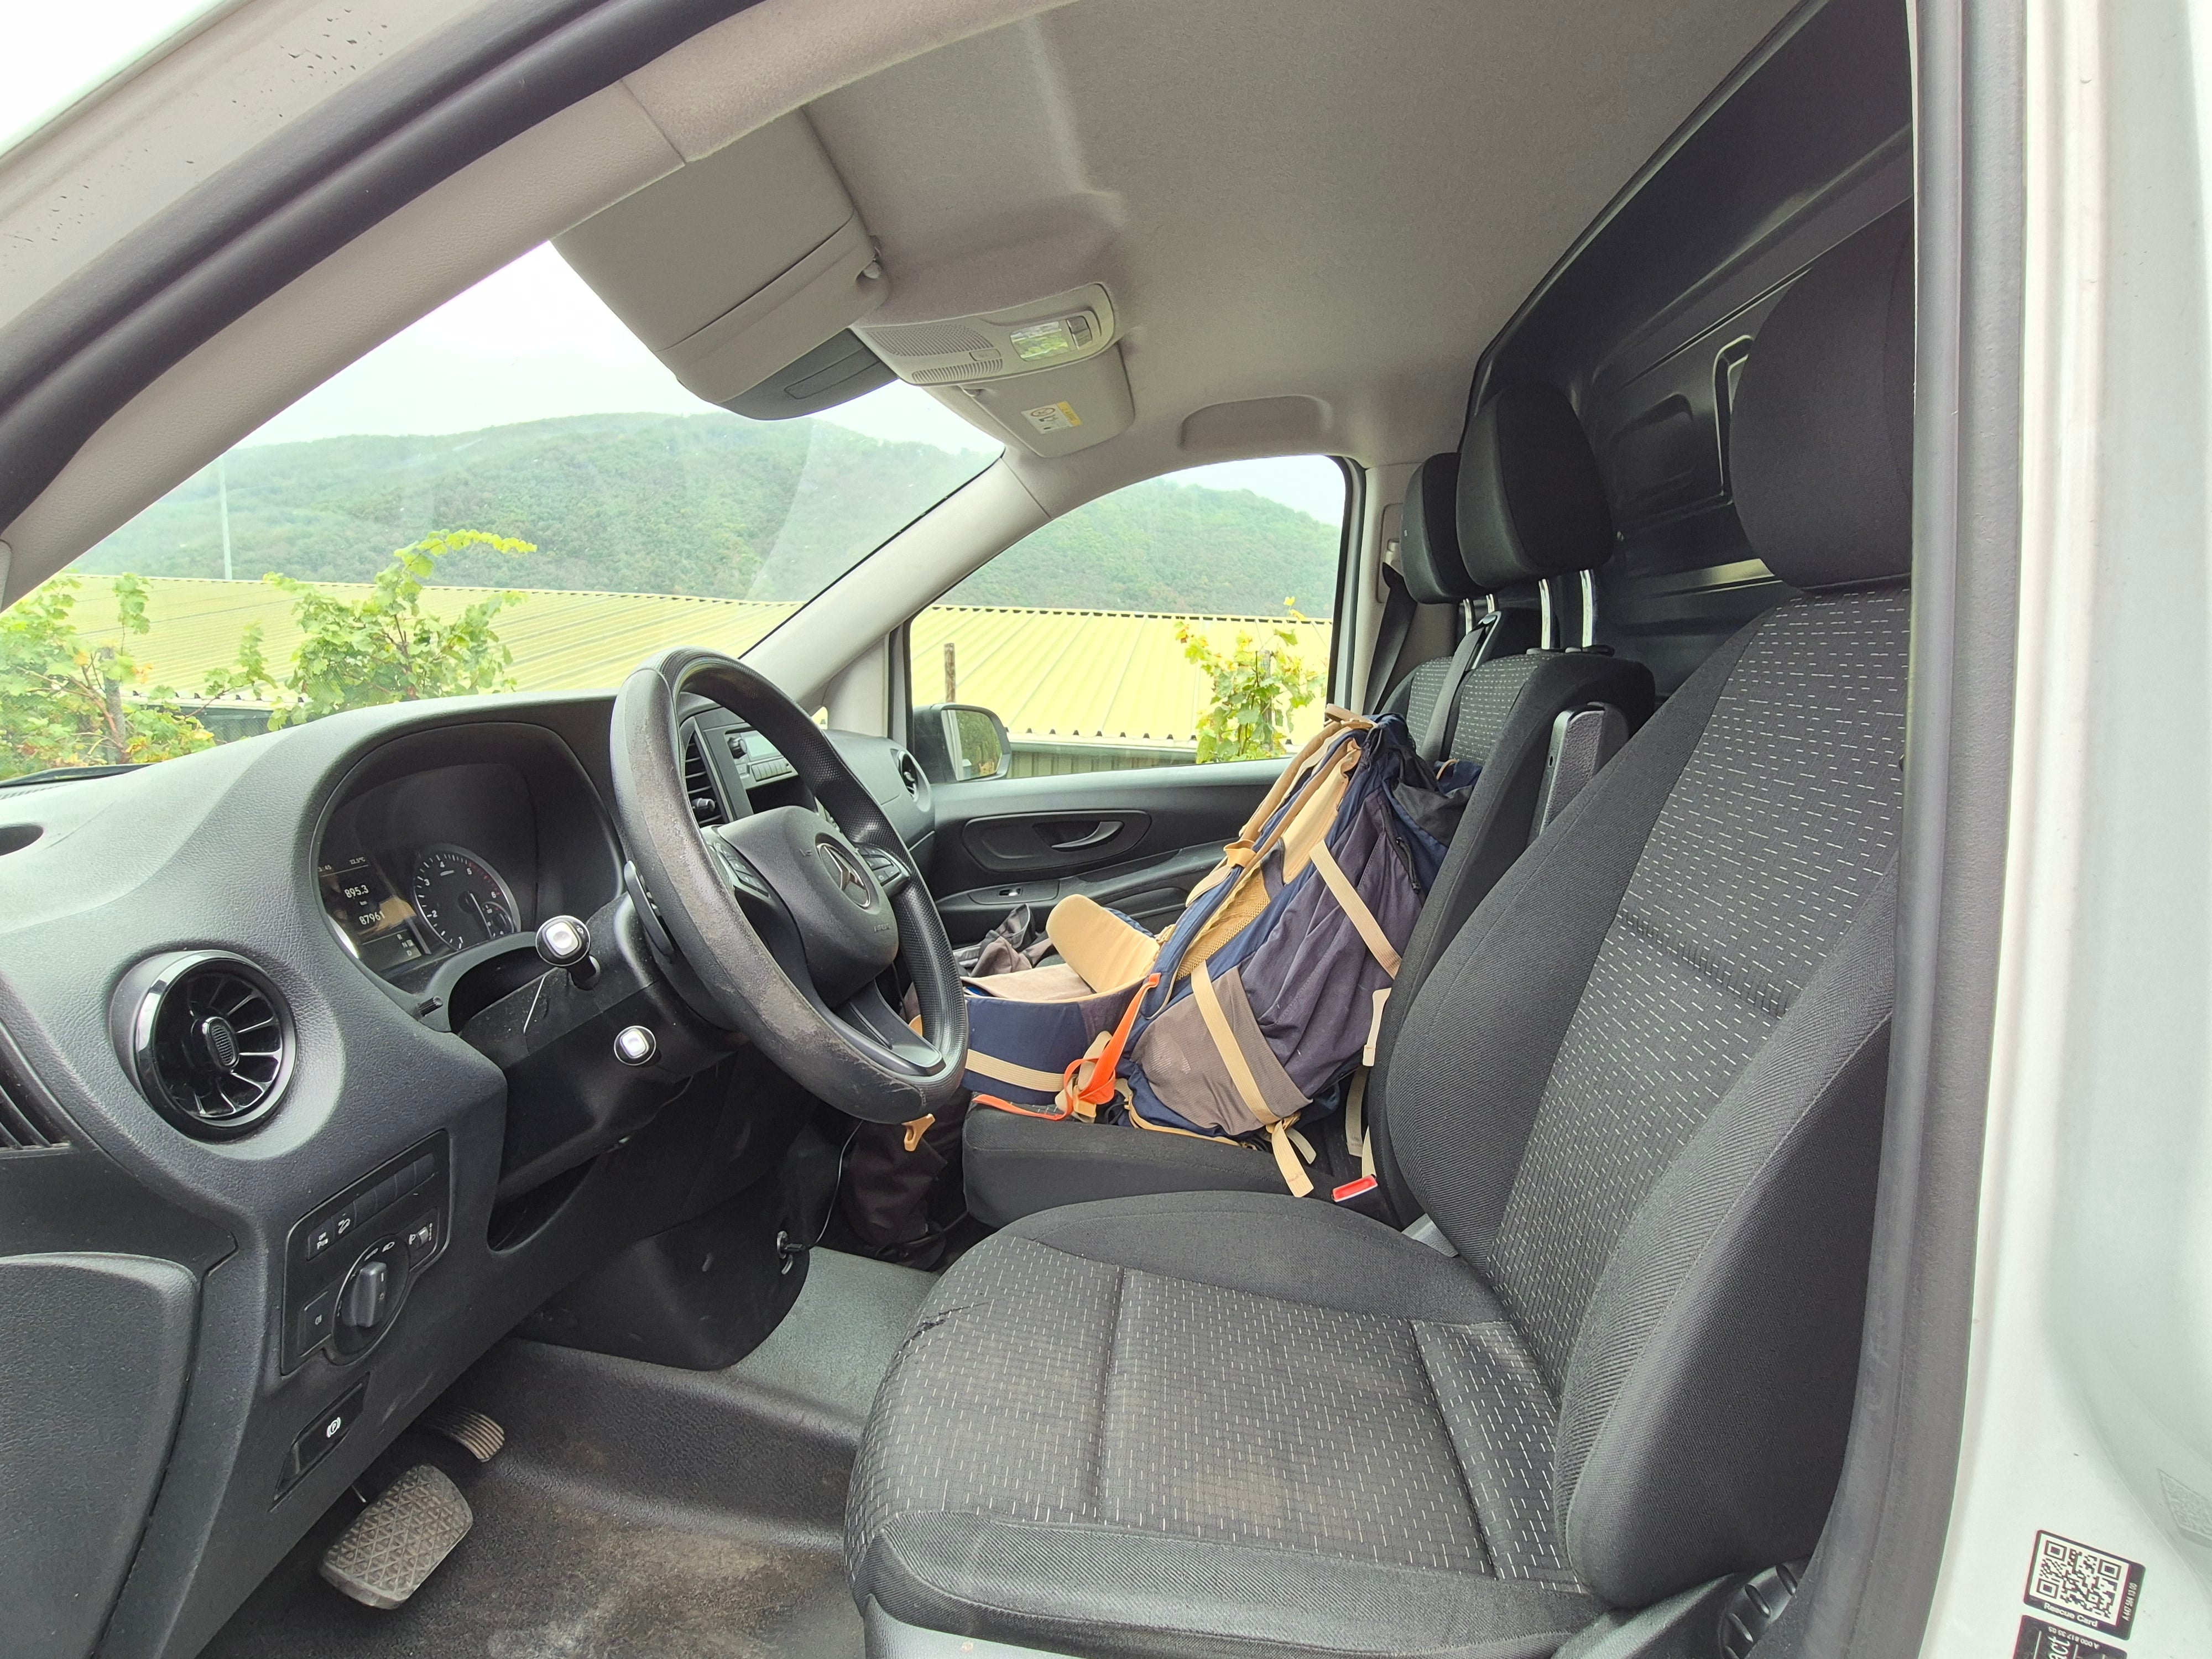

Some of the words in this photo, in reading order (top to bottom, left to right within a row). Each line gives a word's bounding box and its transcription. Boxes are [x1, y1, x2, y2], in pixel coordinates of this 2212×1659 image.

[344, 884, 369, 898] 895.3
[359, 910, 385, 925] 87961
[2044, 1603, 2075, 1619] Rescue
[2077, 1615, 2098, 1627] Card
